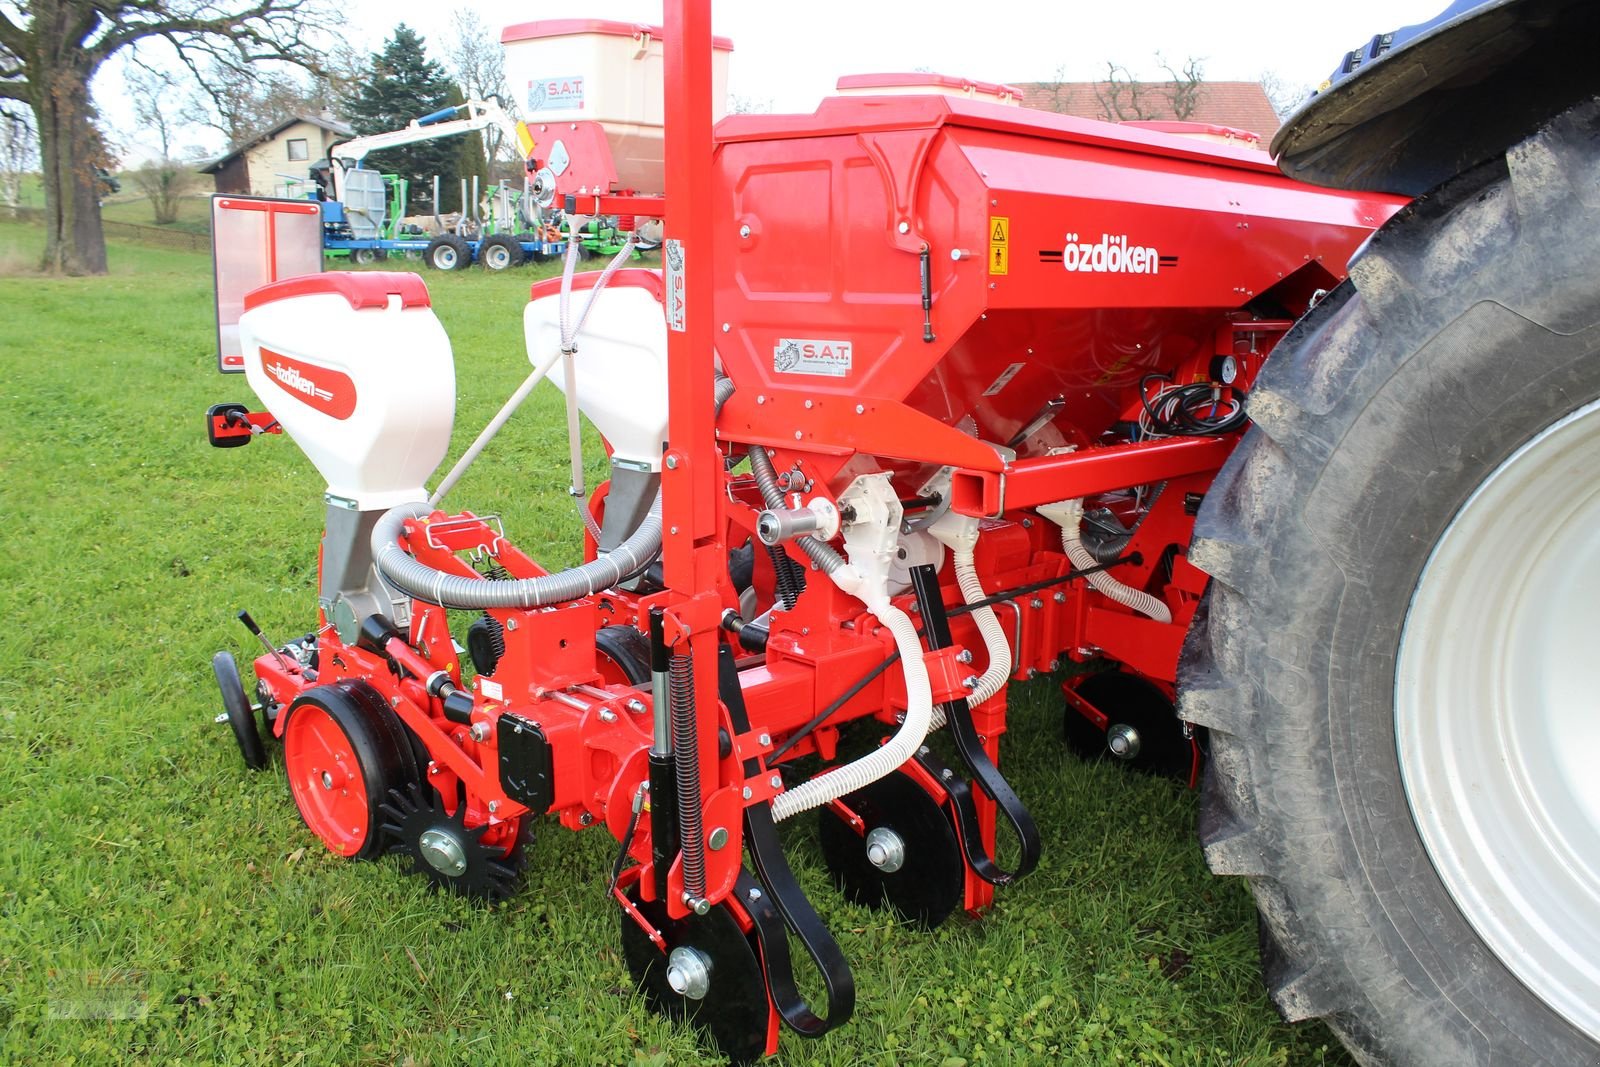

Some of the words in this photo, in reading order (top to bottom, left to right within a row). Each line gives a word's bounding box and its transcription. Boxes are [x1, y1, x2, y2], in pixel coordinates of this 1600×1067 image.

[548, 80, 582, 95] S.A.T.
[1063, 232, 1159, 274] özdöken
[674, 275, 684, 330] S.A.T.
[803, 344, 849, 360] S.A.T.
[276, 362, 315, 396] özdöken
